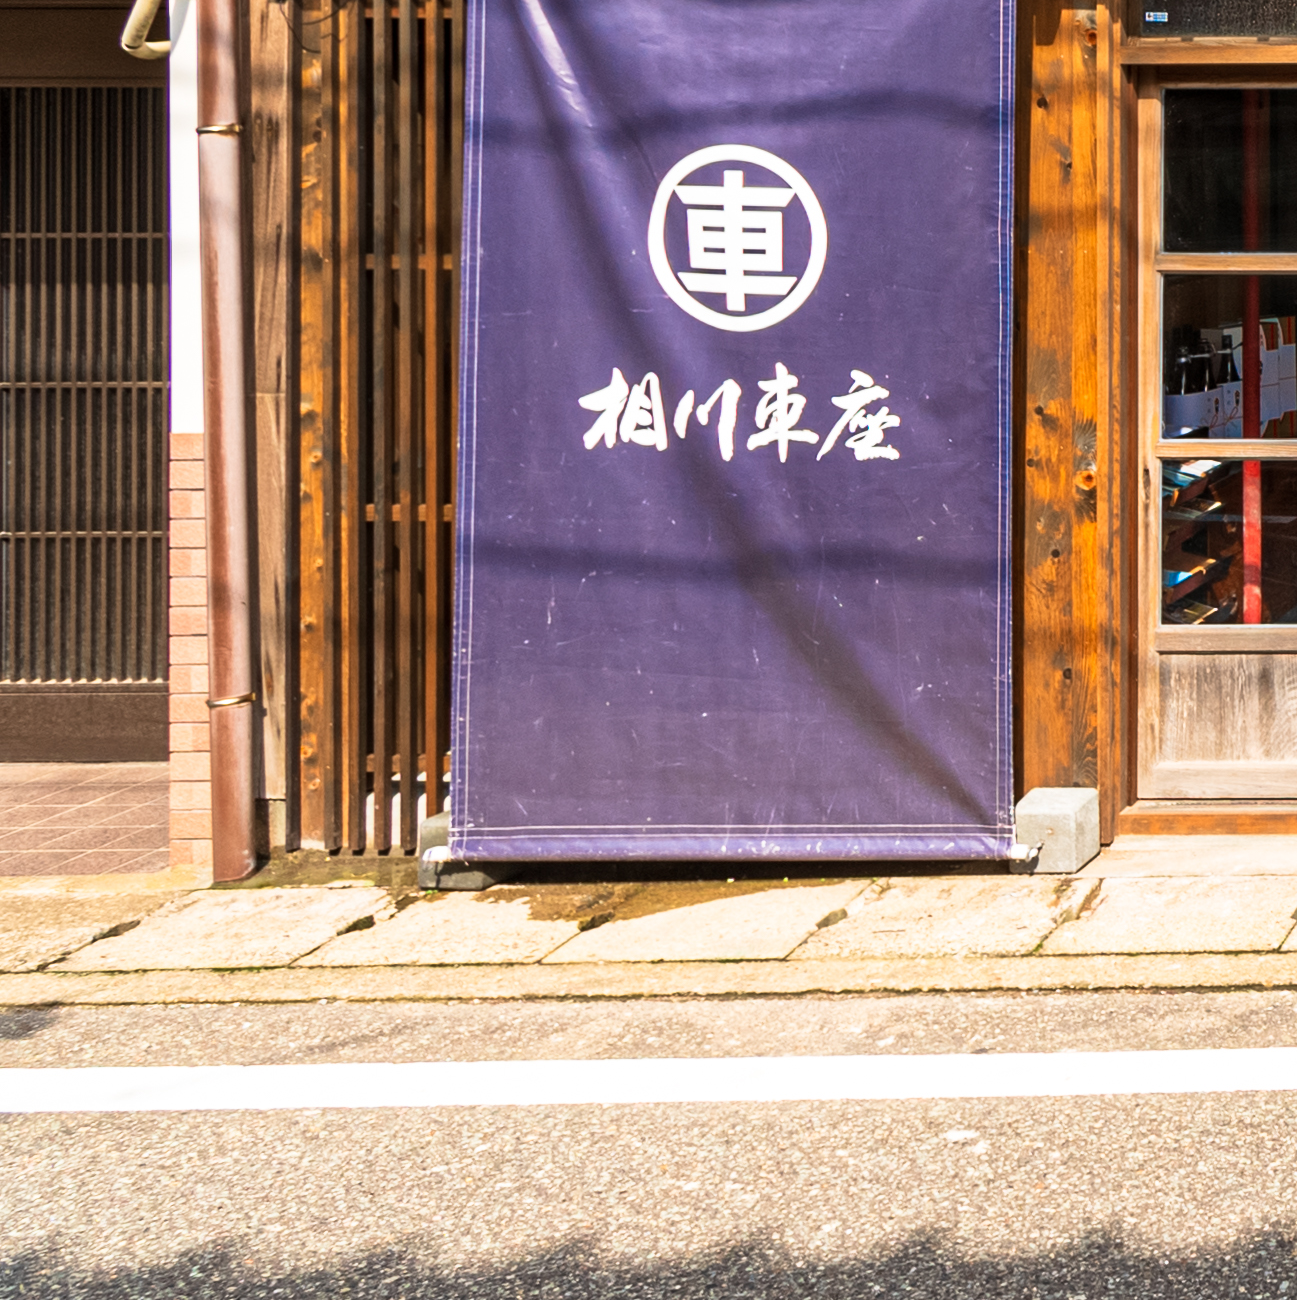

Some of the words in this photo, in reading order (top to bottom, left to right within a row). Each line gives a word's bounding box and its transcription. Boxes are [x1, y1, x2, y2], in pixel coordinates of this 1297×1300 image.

[674, 169, 798, 312] 車
[578, 362, 901, 463] 相川車座
